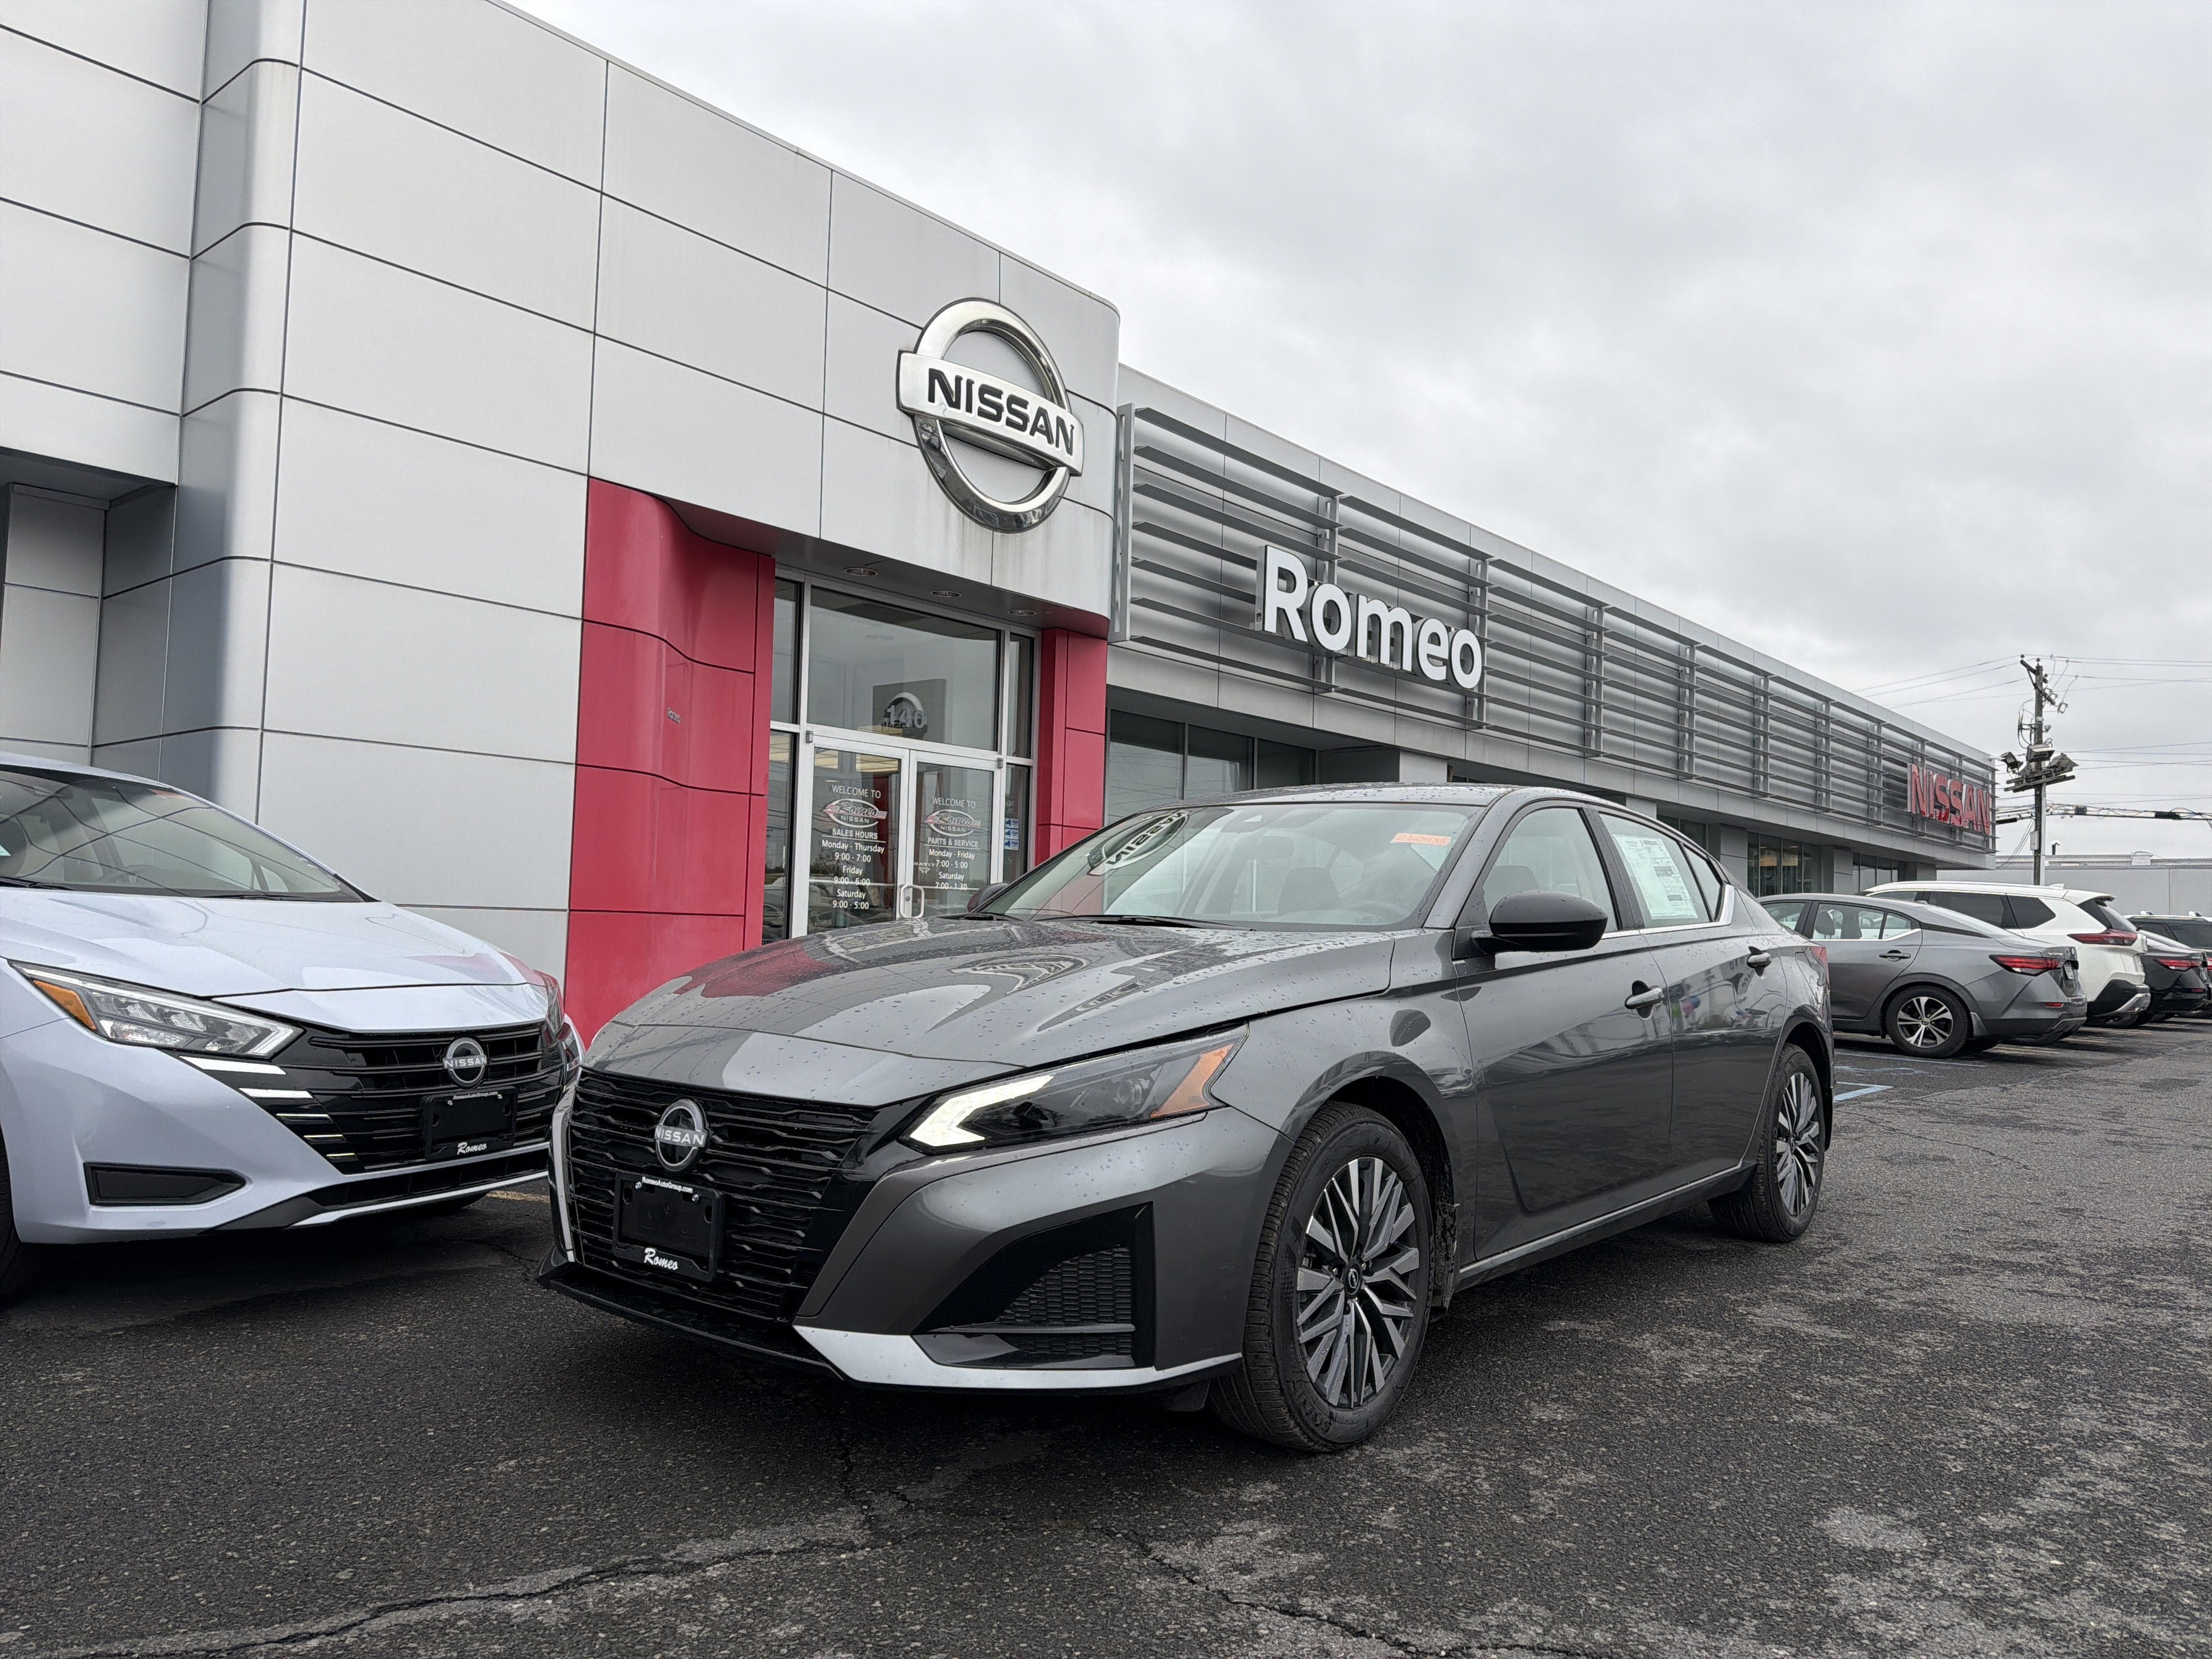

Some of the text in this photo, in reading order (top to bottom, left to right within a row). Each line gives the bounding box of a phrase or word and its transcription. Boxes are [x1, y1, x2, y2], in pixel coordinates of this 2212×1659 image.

[928, 368, 1075, 456] NISSAN
[1262, 545, 1482, 689] Romeo
[887, 705, 926, 729] 140
[832, 785, 881, 799] WELCOME TO
[933, 797, 976, 809] WELCOME TO
[1911, 763, 1990, 834] NISSAN
[835, 800, 877, 816] Romeo
[841, 815, 869, 823] NISSAN
[937, 811, 973, 825] Romeo
[832, 828, 878, 839] SALES HOURS
[822, 839, 849, 851] Monday
[854, 843, 884, 854] Thursday
[954, 839, 979, 848] SERVICE
[834, 852, 850, 861] 9:00
[856, 854, 871, 862] 7:00
[929, 849, 953, 859] Monday
[957, 850, 975, 860] Friday
[843, 865, 863, 876] Friday
[955, 861, 968, 869] 5:00
[834, 876, 849, 884] 9:00
[855, 877, 870, 886] 6:00
[939, 871, 964, 881] Saturday
[837, 889, 866, 899] Saturday
[833, 900, 848, 909] 9:00
[854, 901, 869, 910] 5:00
[444, 1057, 487, 1068] NISSAN
[453, 1091, 498, 1101] RomeoAutoGroup.com
[656, 1127, 704, 1146] NISSAN
[457, 1142, 487, 1155] Romeo
[642, 1176, 693, 1193] RomeoAutoGroup.com
[644, 1248, 679, 1270] Romeo
